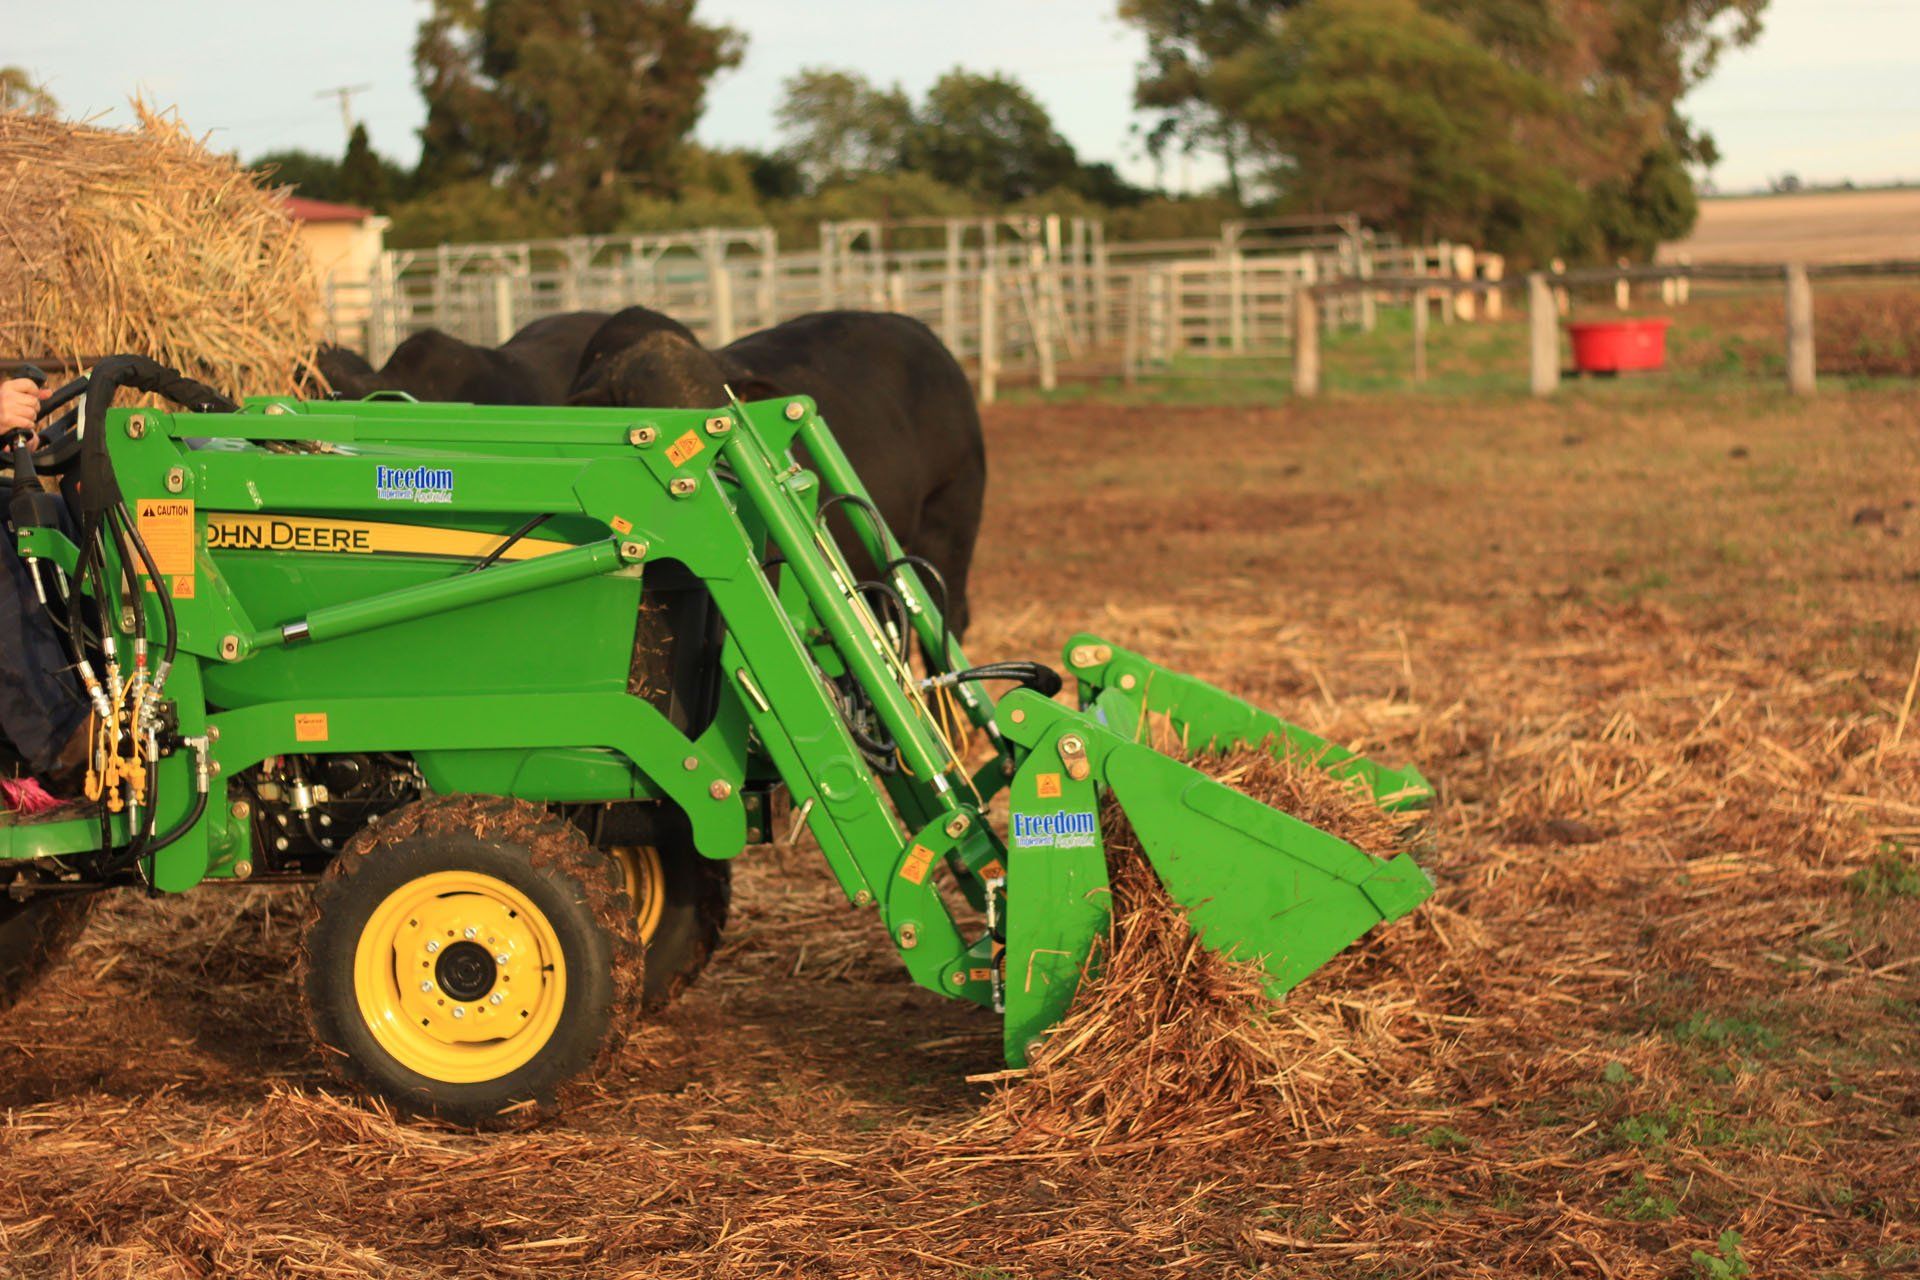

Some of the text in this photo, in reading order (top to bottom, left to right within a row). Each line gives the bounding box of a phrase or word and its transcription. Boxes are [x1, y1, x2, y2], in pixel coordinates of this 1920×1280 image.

[377, 465, 453, 489] Freedom
[156, 505, 189, 516] CAUTION
[207, 521, 370, 549] OHN DEERE
[1013, 810, 1094, 837] Freedom
